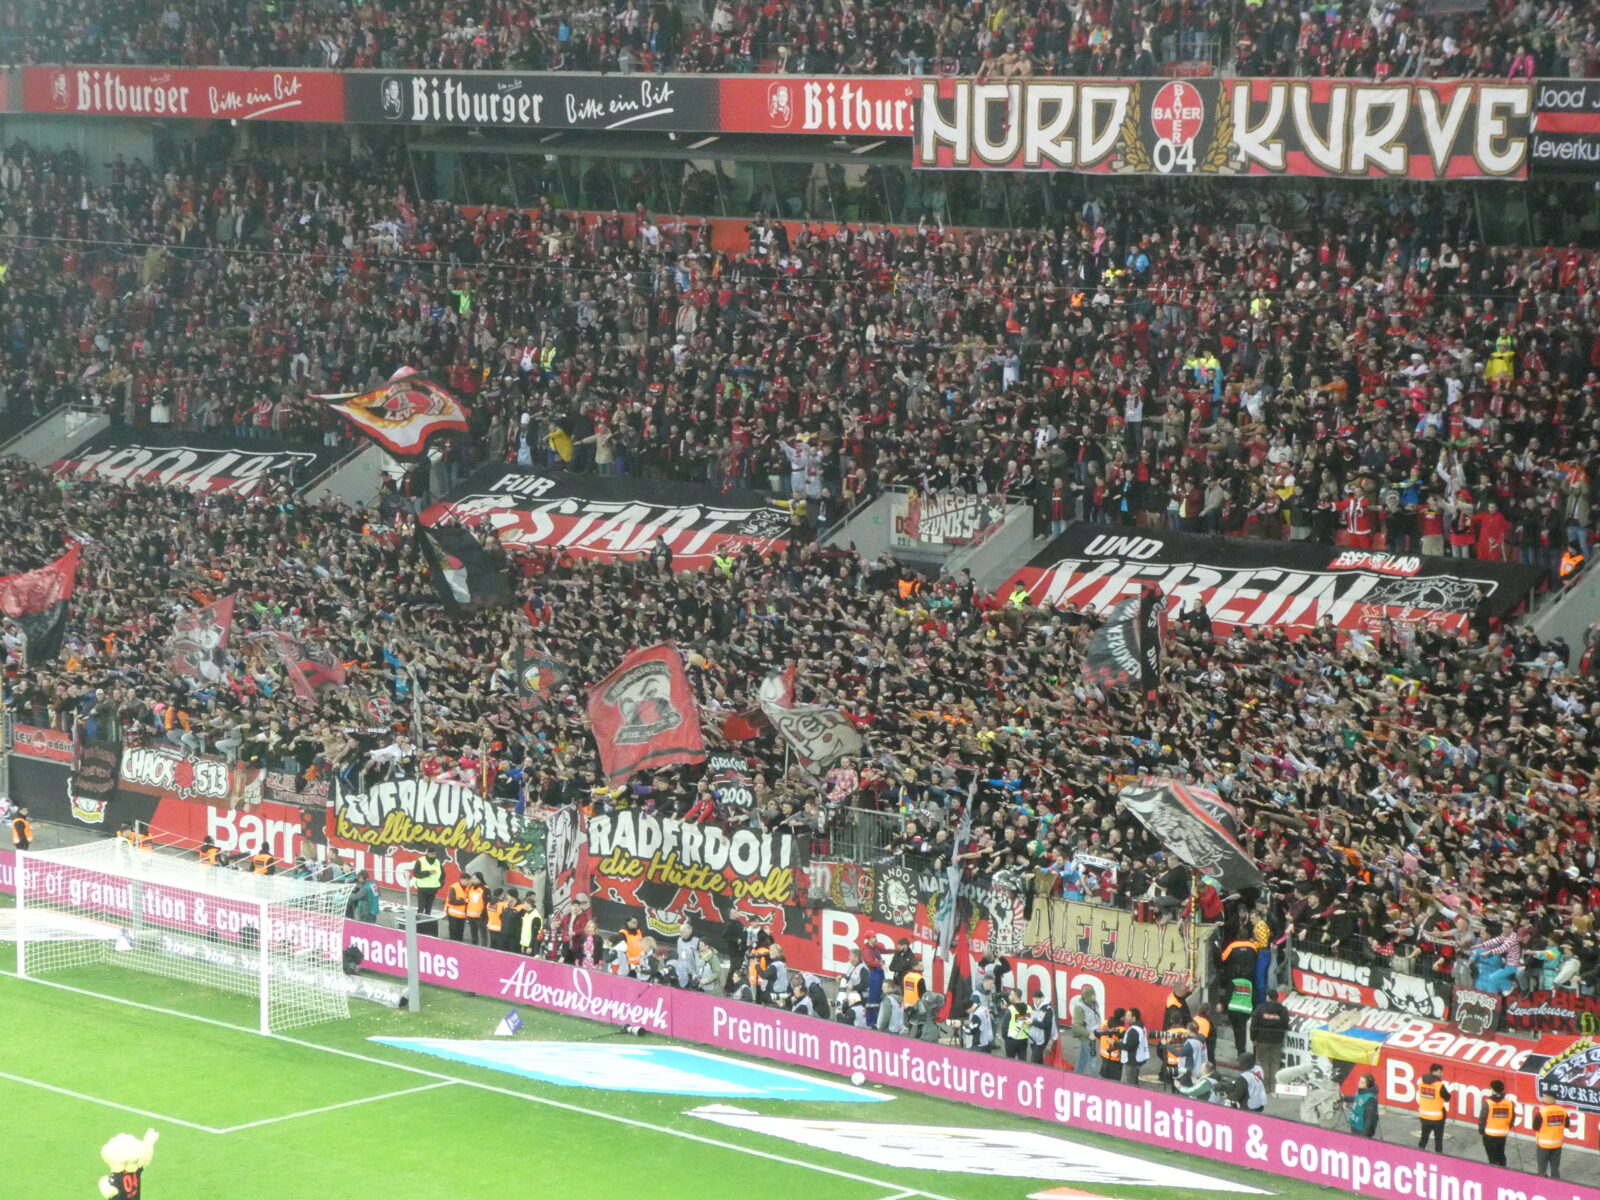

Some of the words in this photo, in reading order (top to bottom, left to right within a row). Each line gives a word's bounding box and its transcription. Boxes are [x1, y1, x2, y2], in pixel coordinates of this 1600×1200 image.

[76, 69, 190, 115] Bitburger
[208, 86, 245, 114] Bitte
[247, 88, 272, 105] ein
[273, 73, 303, 98] Bit
[411, 76, 544, 124] Bitburger
[565, 94, 606, 124] Bitte
[609, 91, 638, 111] ein
[640, 80, 675, 108] Bit
[1153, 105, 1202, 121] BAYER
[1231, 81, 1531, 175] KURVE
[1152, 138, 1197, 173] 04
[489, 473, 556, 497] FÜR
[514, 499, 751, 555] STADT
[919, 506, 977, 539] SKUNKS
[1083, 534, 1165, 560] UND
[1037, 560, 1382, 627] VEREIN
[194, 760, 229, 797] 513
[719, 787, 753, 808] 2009
[599, 848, 644, 878] die
[646, 851, 728, 892] Hütte
[731, 865, 794, 903] voll
[878, 867, 910, 921] COMMANDO
[45, 869, 65, 897] of
[69, 879, 187, 922] granultion
[193, 897, 209, 927] &
[349, 934, 460, 982] machnes
[1296, 950, 1372, 988] YOUNG
[1301, 973, 1362, 1004] BOYS
[1506, 1001, 1577, 1019] Leverkusen
[499, 960, 669, 1031] Alexanderwerk
[712, 1005, 821, 1060] Premium
[829, 1038, 1009, 1101] manufacturer
[1017, 1076, 1045, 1109] of
[1054, 1086, 1233, 1153] granulation
[1245, 1123, 1269, 1162] &
[1280, 1137, 1482, 1200] compacting
